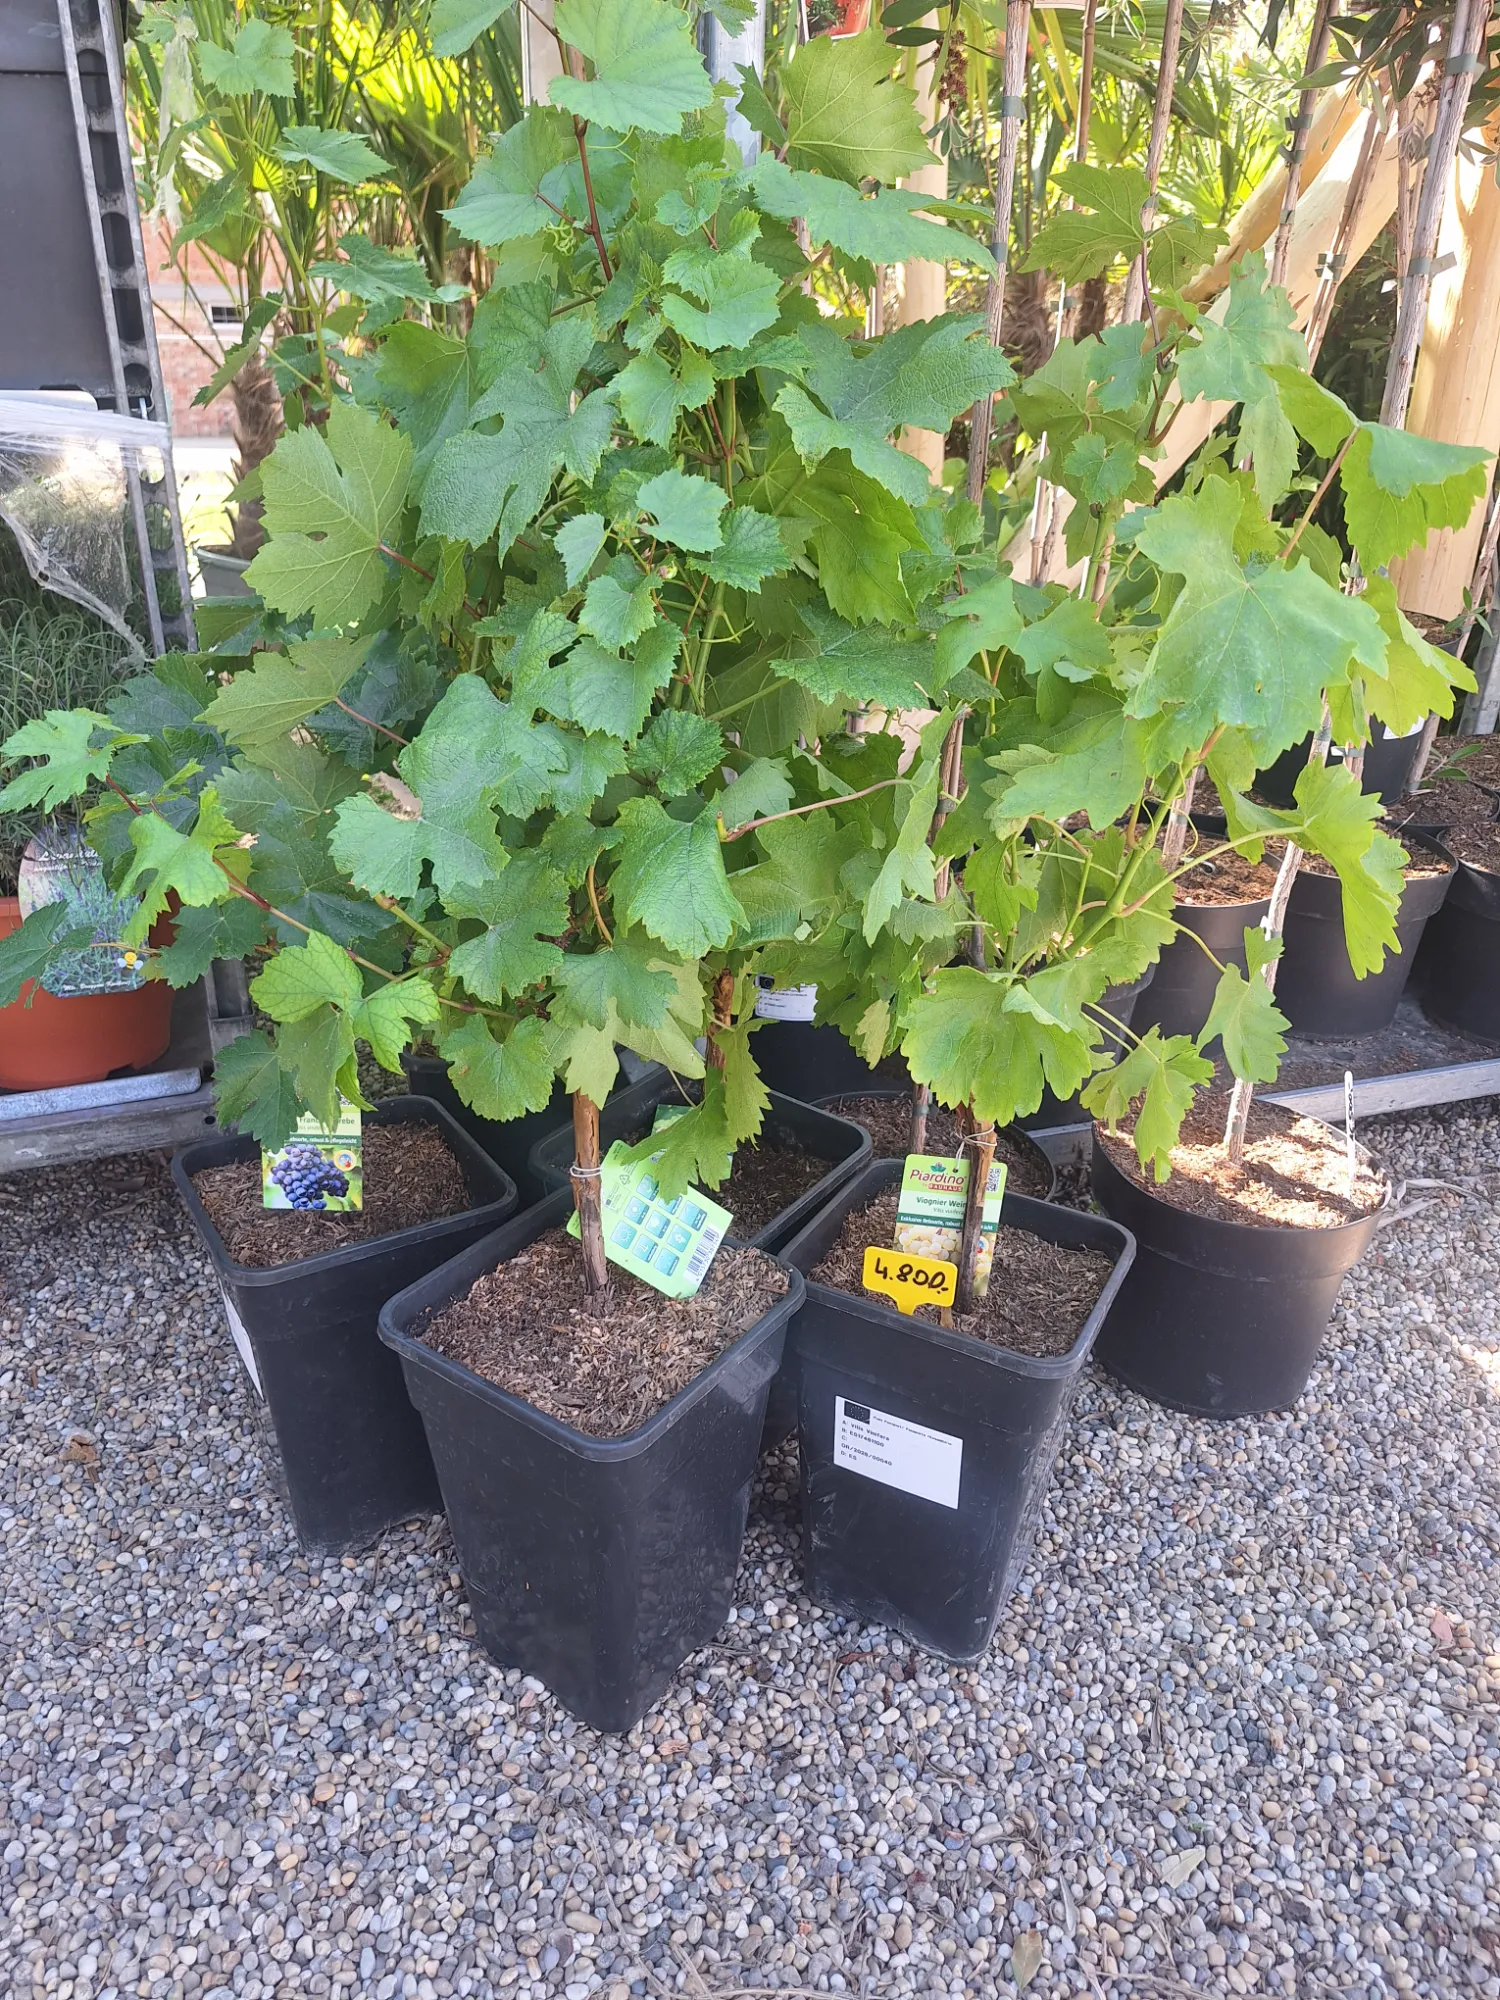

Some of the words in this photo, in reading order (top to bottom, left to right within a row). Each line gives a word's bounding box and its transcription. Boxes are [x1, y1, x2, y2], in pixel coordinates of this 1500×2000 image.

[910, 1168, 964, 1185] Piardino
[928, 1184, 962, 1192] BAUHAUS
[916, 1196, 947, 1206] Viognier
